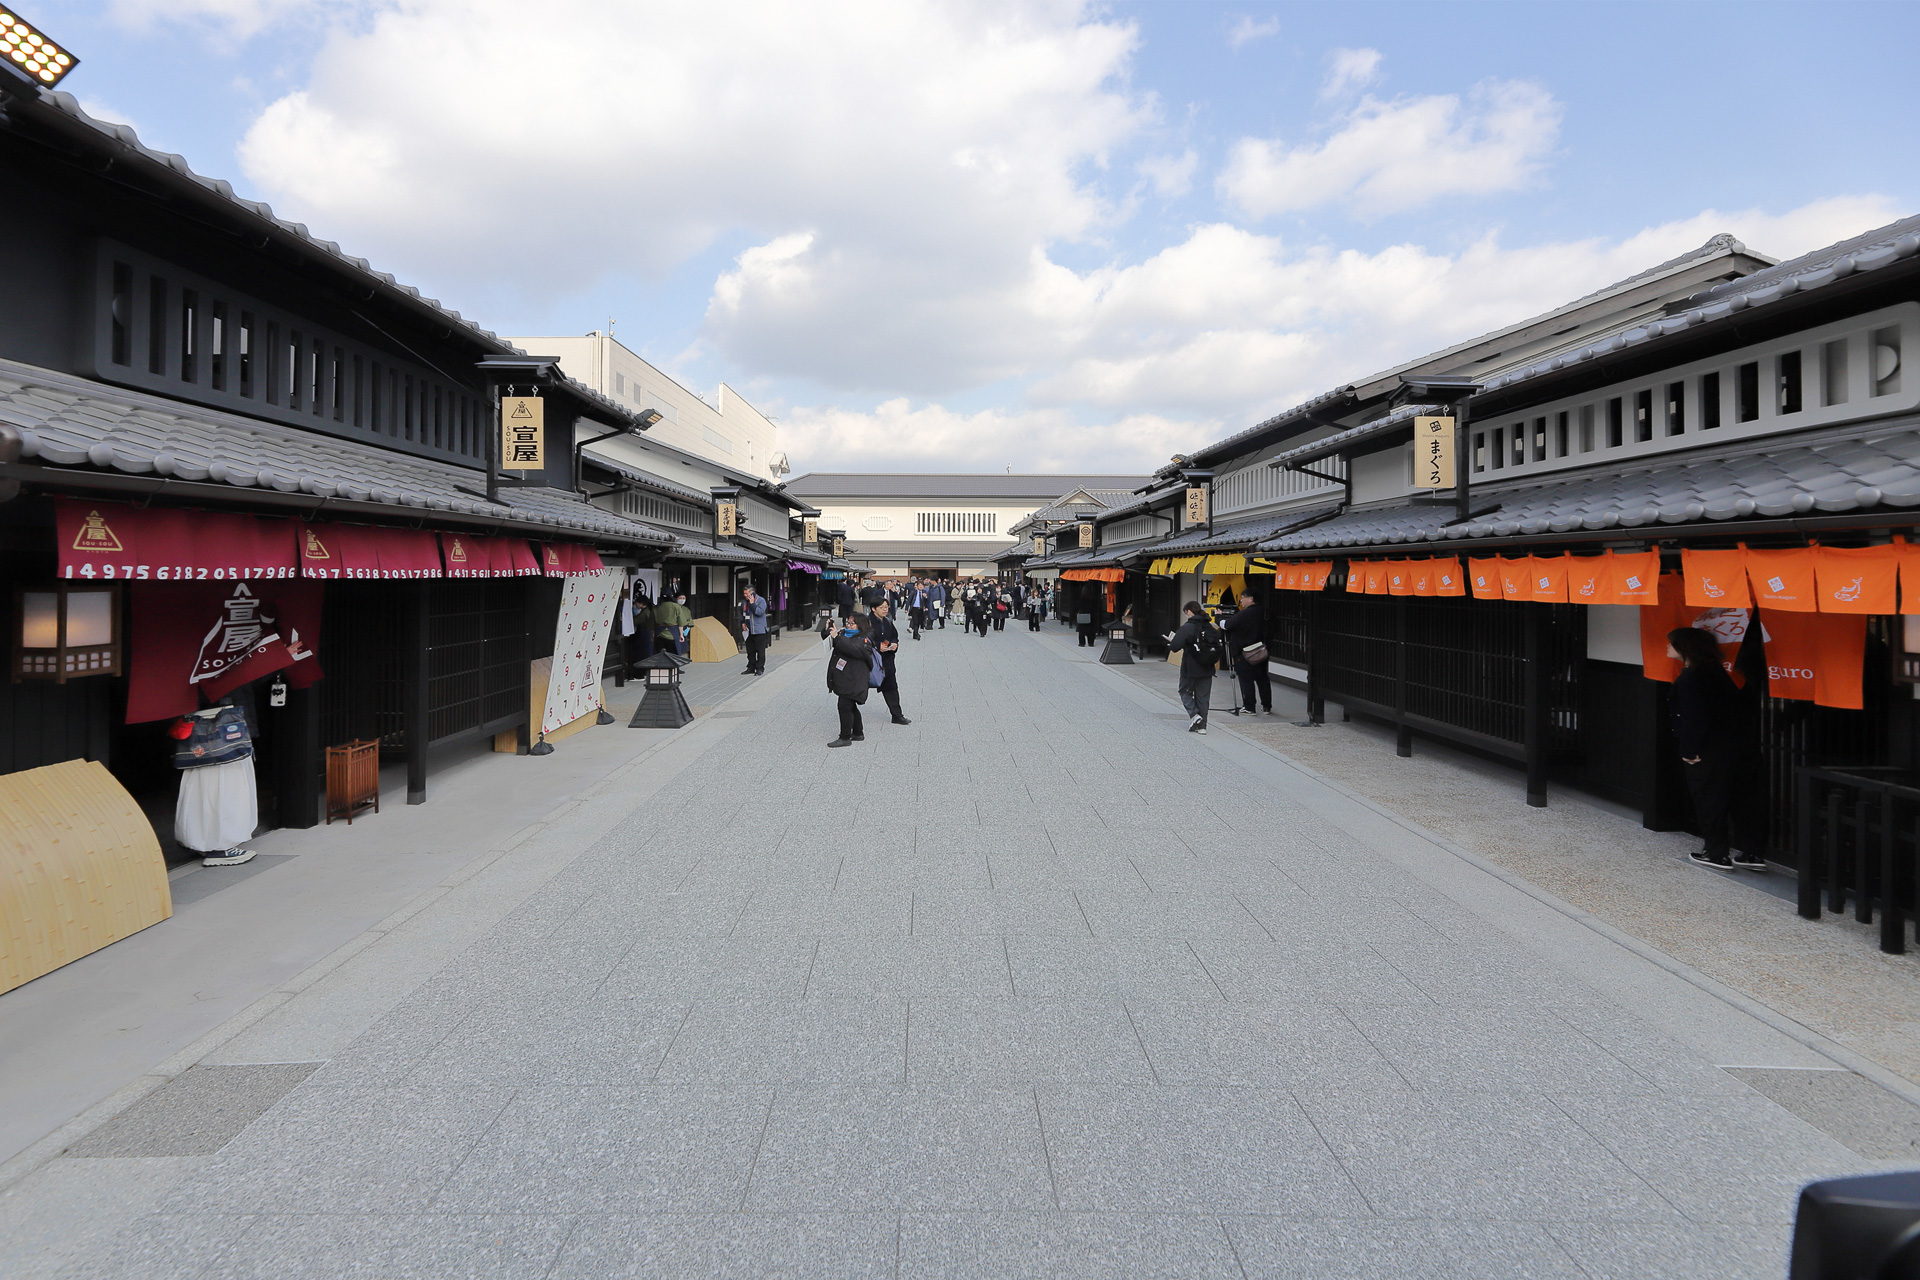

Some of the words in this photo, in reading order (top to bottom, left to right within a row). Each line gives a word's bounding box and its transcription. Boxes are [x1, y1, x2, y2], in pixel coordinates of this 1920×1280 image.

[512, 426, 538, 462] 宣屋
[1430, 439, 1443, 484] まぐろ
[588, 594, 594, 602] 0
[566, 623, 572, 632] 9
[581, 620, 588, 630] 8
[576, 650, 582, 660] 4
